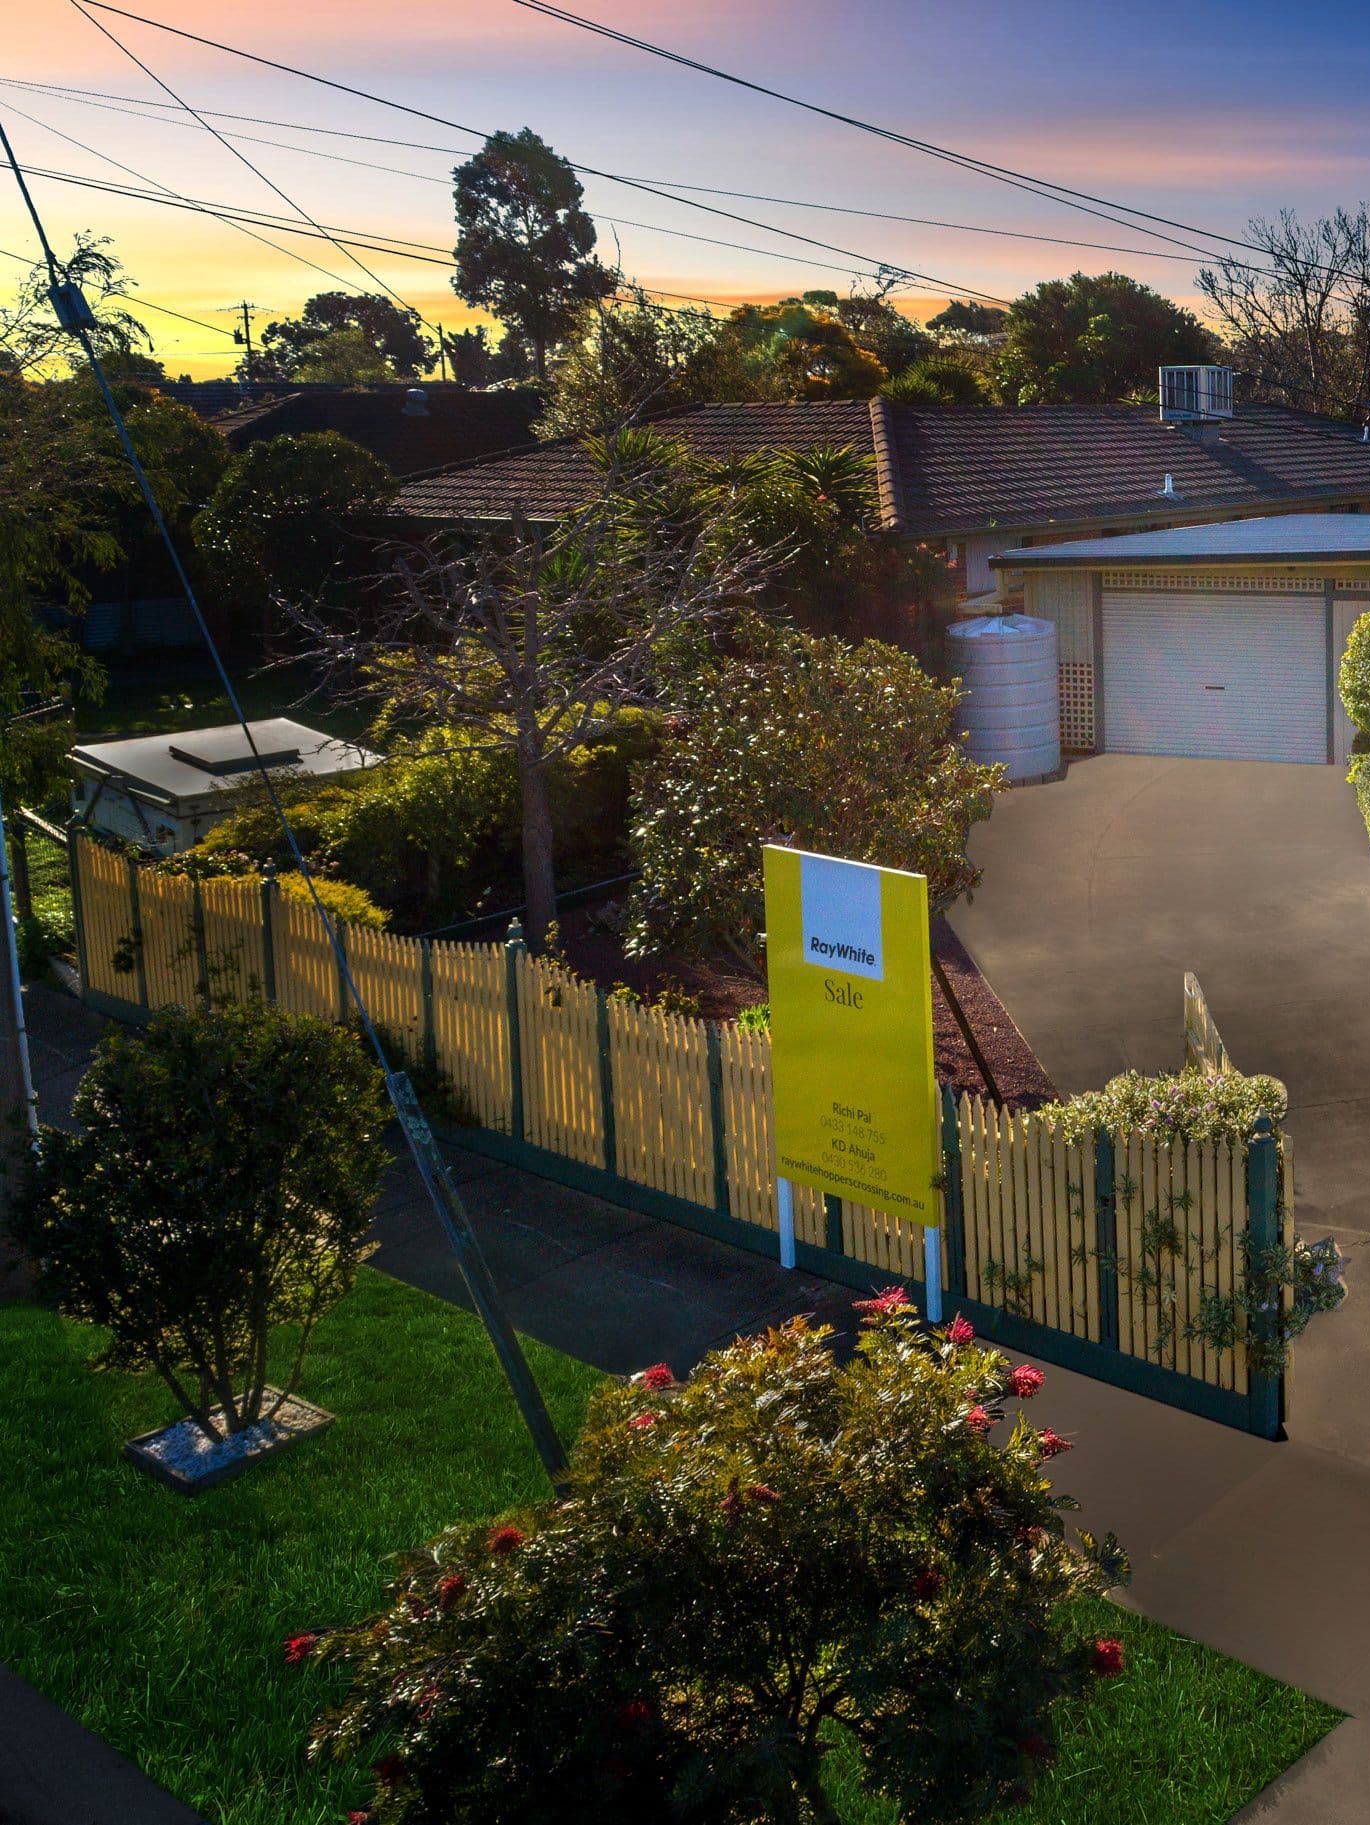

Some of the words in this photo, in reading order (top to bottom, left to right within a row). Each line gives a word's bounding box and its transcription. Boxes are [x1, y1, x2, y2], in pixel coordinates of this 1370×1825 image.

[825, 979, 863, 1009] Sale
[819, 1115, 844, 1133] 0433
[832, 1102, 855, 1120] Richi
[857, 1109, 872, 1124] Pal
[831, 1138, 846, 1152] KD
[849, 1143, 876, 1162] Ahuja
[781, 1156, 925, 1210] raywhitehopperscrossing.com.au
